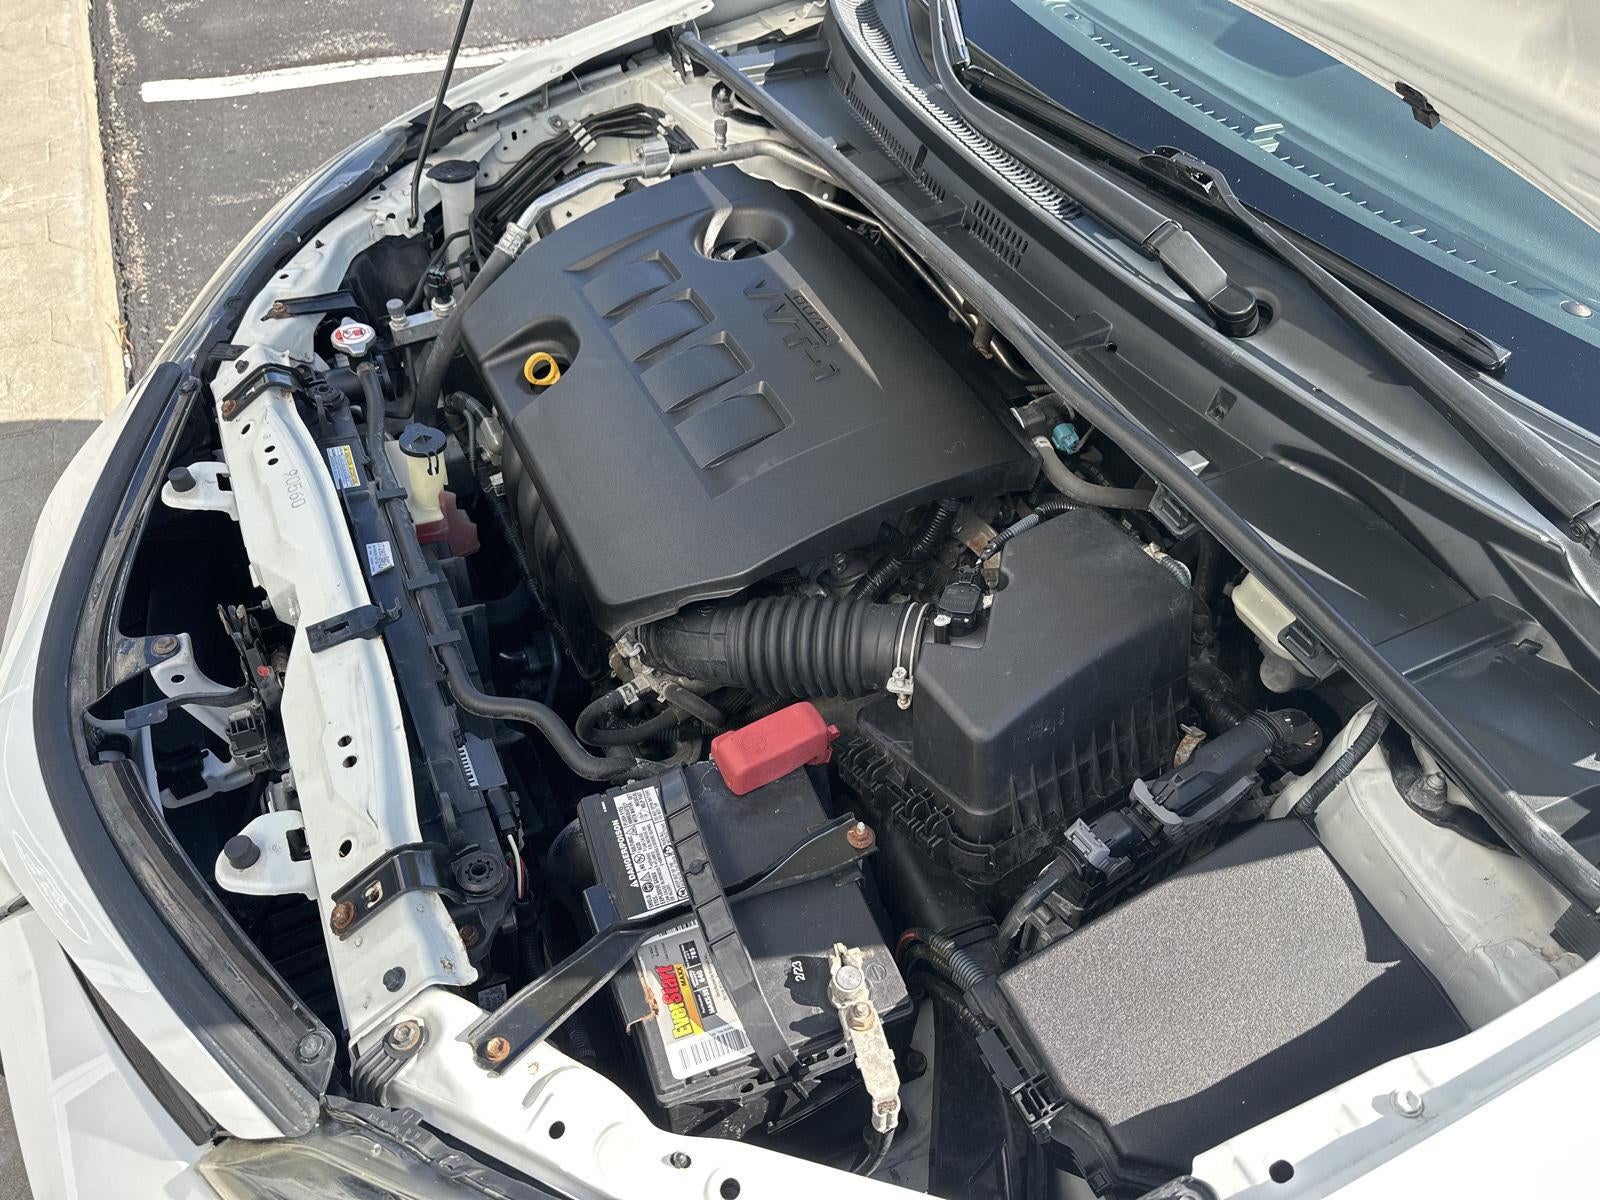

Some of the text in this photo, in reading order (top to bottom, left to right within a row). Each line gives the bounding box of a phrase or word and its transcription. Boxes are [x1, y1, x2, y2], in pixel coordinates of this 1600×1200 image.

[792, 295, 829, 337] DUAL
[283, 468, 305, 508] 90560
[611, 818, 636, 880] DANGER/POISON
[689, 946, 697, 959] 785
[791, 960, 805, 980] 2/23
[675, 965, 687, 986] MAXX
[655, 964, 693, 1039] EverStart
